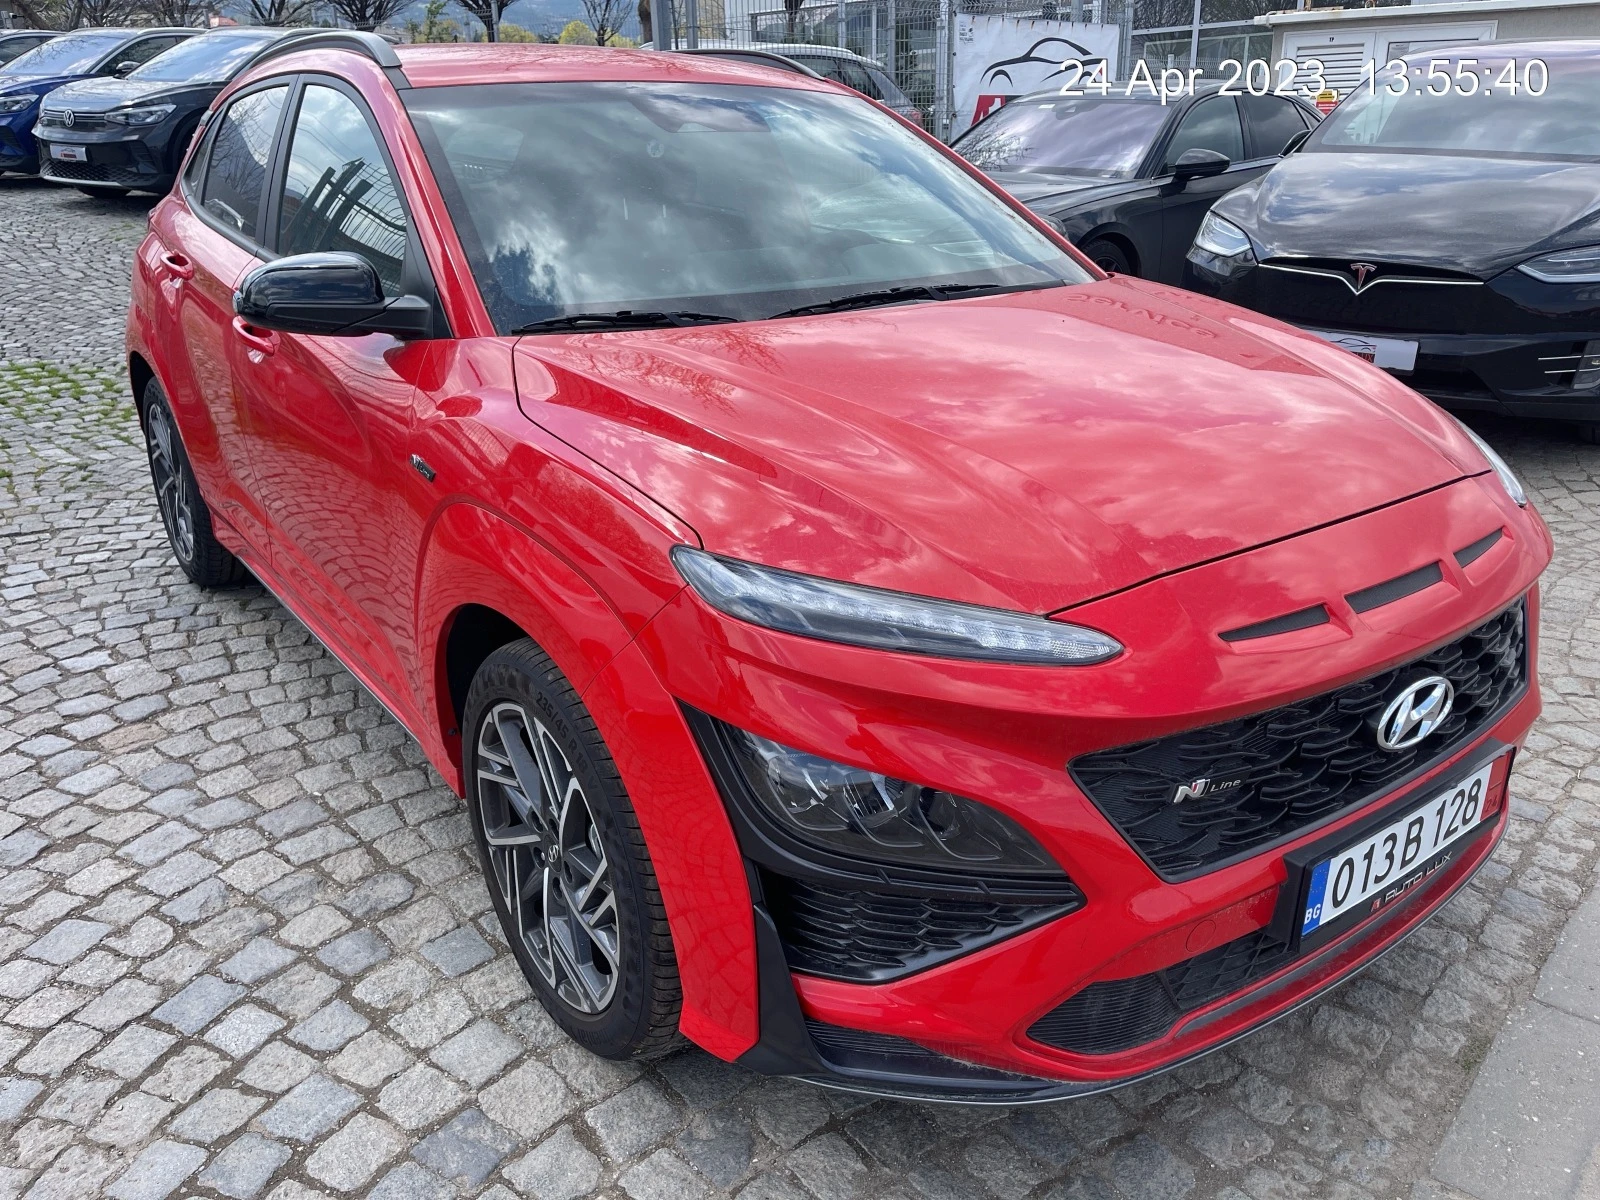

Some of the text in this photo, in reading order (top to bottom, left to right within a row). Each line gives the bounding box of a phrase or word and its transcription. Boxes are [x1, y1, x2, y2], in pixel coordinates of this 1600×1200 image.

[1174, 779, 1210, 803] N
[1304, 903, 1322, 925] BG
[1433, 777, 1482, 849] 128
[1385, 871, 1423, 903] AUTO
[1426, 850, 1453, 877] LUX
